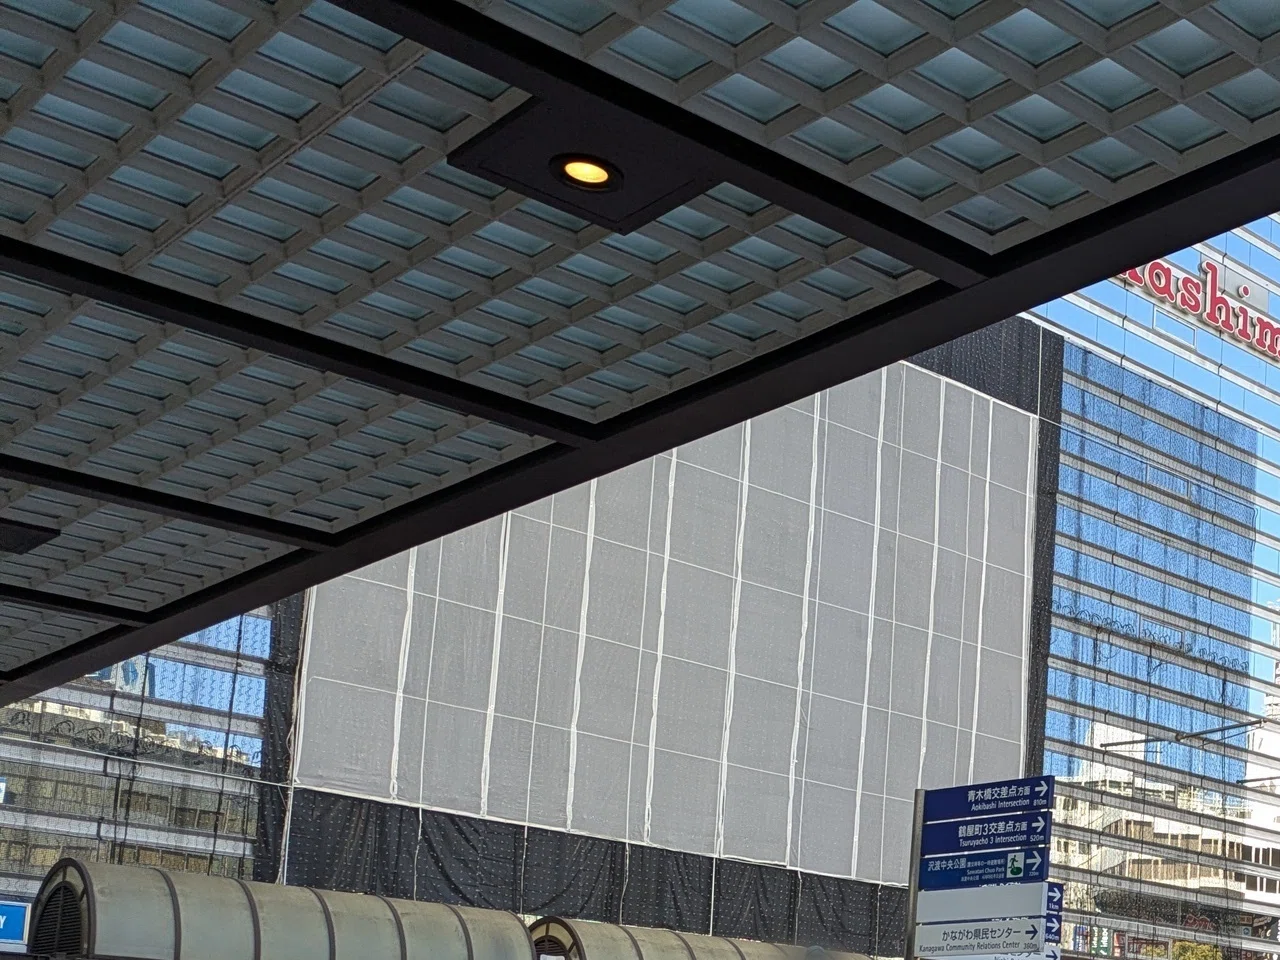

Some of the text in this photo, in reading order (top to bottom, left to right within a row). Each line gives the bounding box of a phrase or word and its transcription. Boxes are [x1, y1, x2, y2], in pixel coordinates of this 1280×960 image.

[998, 798, 1030, 809] Intersection
[995, 833, 1027, 844] Intersection
[941, 926, 1022, 942] かながわ県民センター
[919, 943, 945, 954] Kanagawa
[945, 942, 976, 952] Community
[976, 941, 1001, 950] Relations
[1002, 940, 1020, 949] Center
